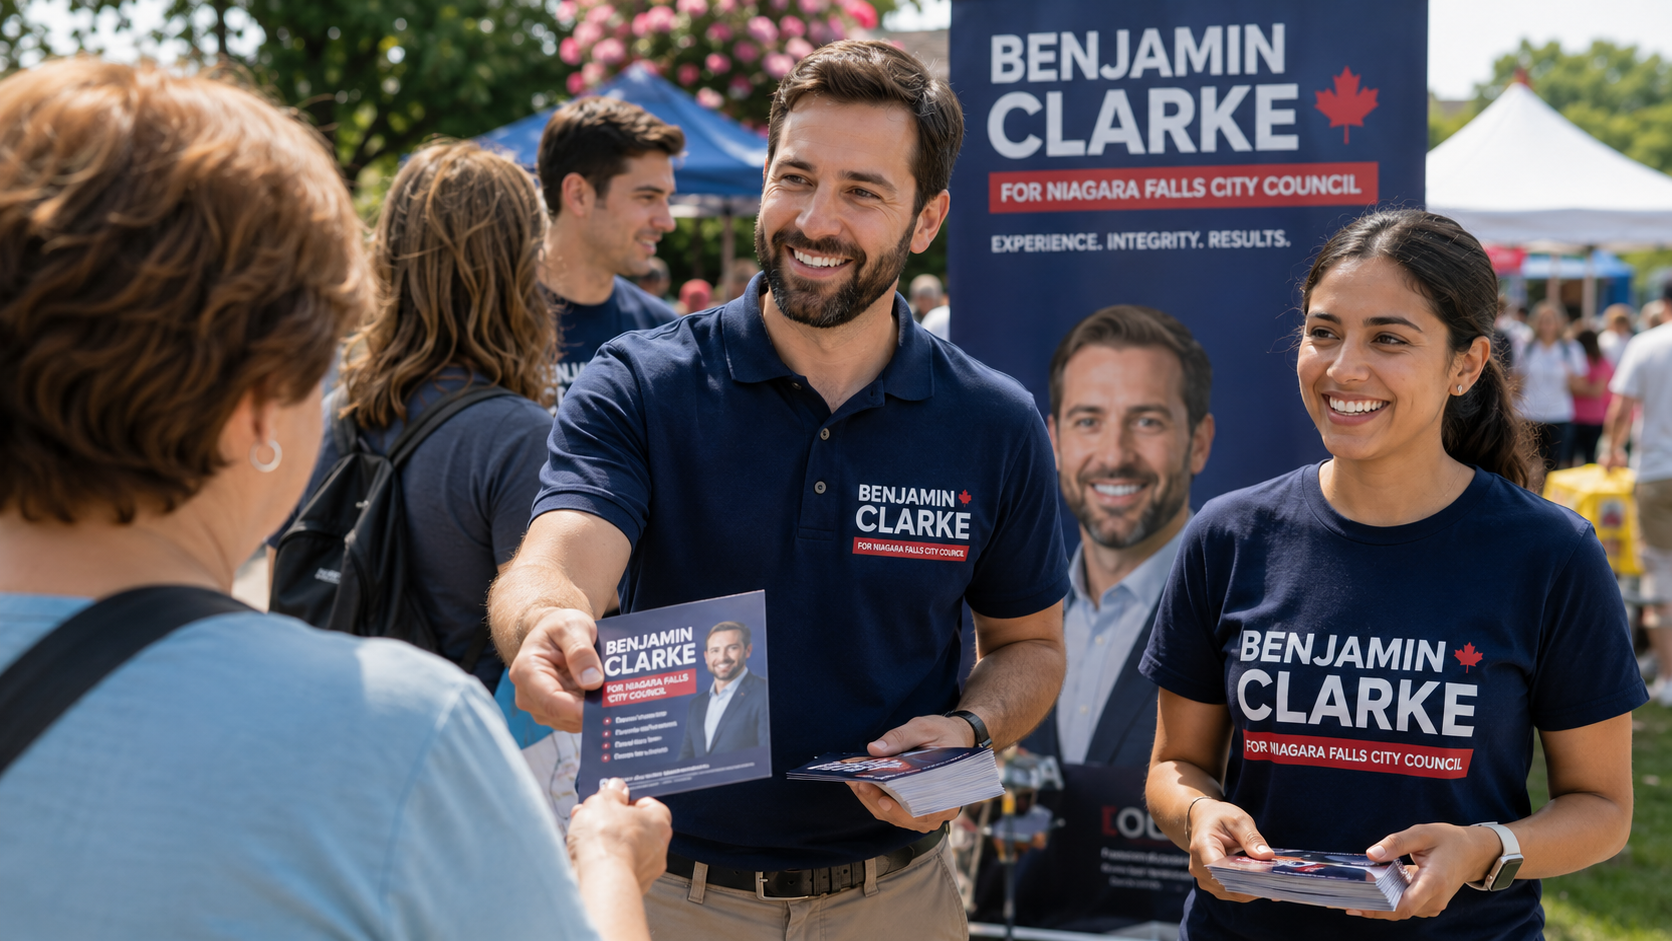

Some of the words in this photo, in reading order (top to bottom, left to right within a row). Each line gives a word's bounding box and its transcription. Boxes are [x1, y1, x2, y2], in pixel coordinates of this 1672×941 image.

[991, 23, 1285, 84] BENJAMIN
[988, 84, 1298, 158] CLARKE
[1001, 182, 1041, 202] FOR
[1047, 180, 1140, 200] NIAGARA
[1145, 178, 1206, 198] FALLS
[1211, 177, 1258, 197] CITY
[1263, 175, 1361, 196] COUNCIL
[992, 233, 1103, 252] EXPERIENCE.
[1108, 232, 1203, 250] INTEGRITY.
[1209, 230, 1290, 248] RESULTS.
[858, 484, 955, 507] BENJAMIN
[856, 505, 971, 540] CLARKE
[858, 542, 872, 550] FOR
[873, 544, 904, 552] NIAGARA
[905, 546, 923, 554] FALLS
[606, 626, 692, 655] BENJAMIN
[1240, 630, 1446, 673] BENJAMIN
[604, 642, 696, 677] CLARKE
[607, 684, 624, 693] FOR
[626, 678, 663, 691] NIAGARA
[664, 673, 689, 685] FALLS
[1237, 668, 1477, 737] CLARKE
[1246, 740, 1267, 752] FOR
[1270, 742, 1325, 758] NIAGARA
[1330, 747, 1367, 762] FALLS
[1371, 751, 1401, 765] CITY
[1405, 754, 1462, 770] COUNCIL
